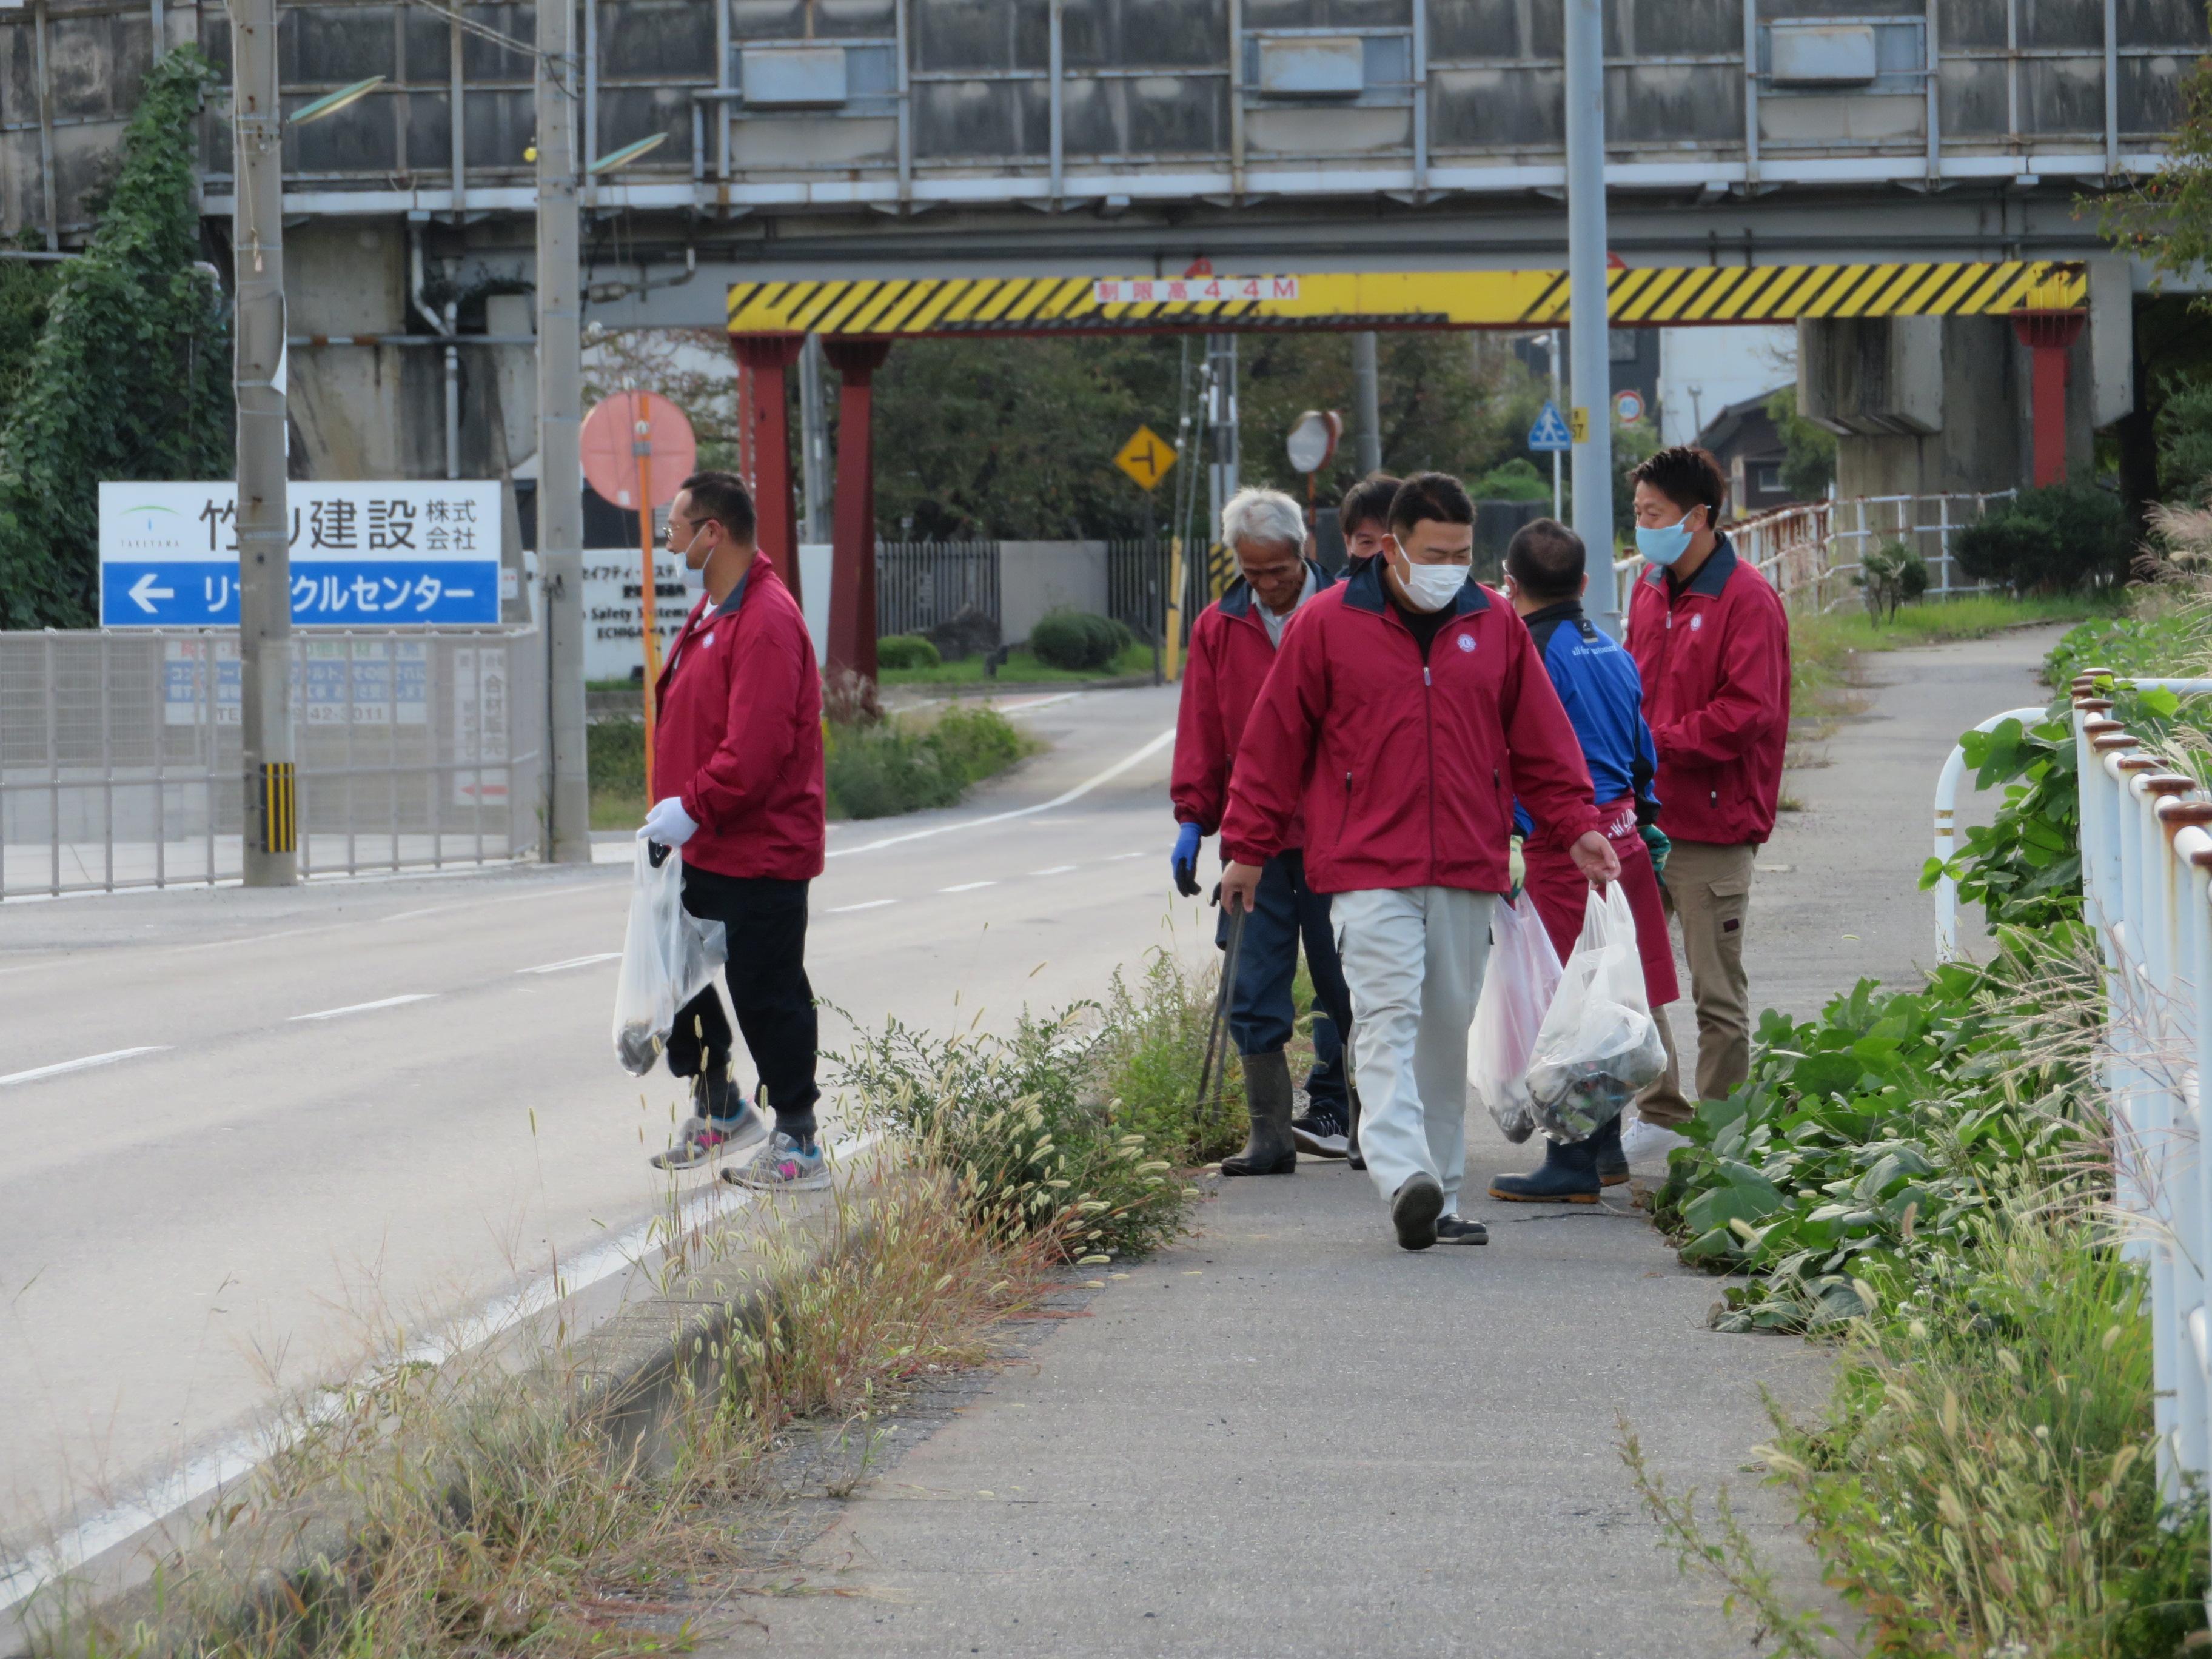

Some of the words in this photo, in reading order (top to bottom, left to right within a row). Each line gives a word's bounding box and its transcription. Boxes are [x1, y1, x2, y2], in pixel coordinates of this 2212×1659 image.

[199, 498, 417, 551] 竹建設
[205, 575, 475, 612] リクルセンター
[591, 608, 631, 622] Safety
